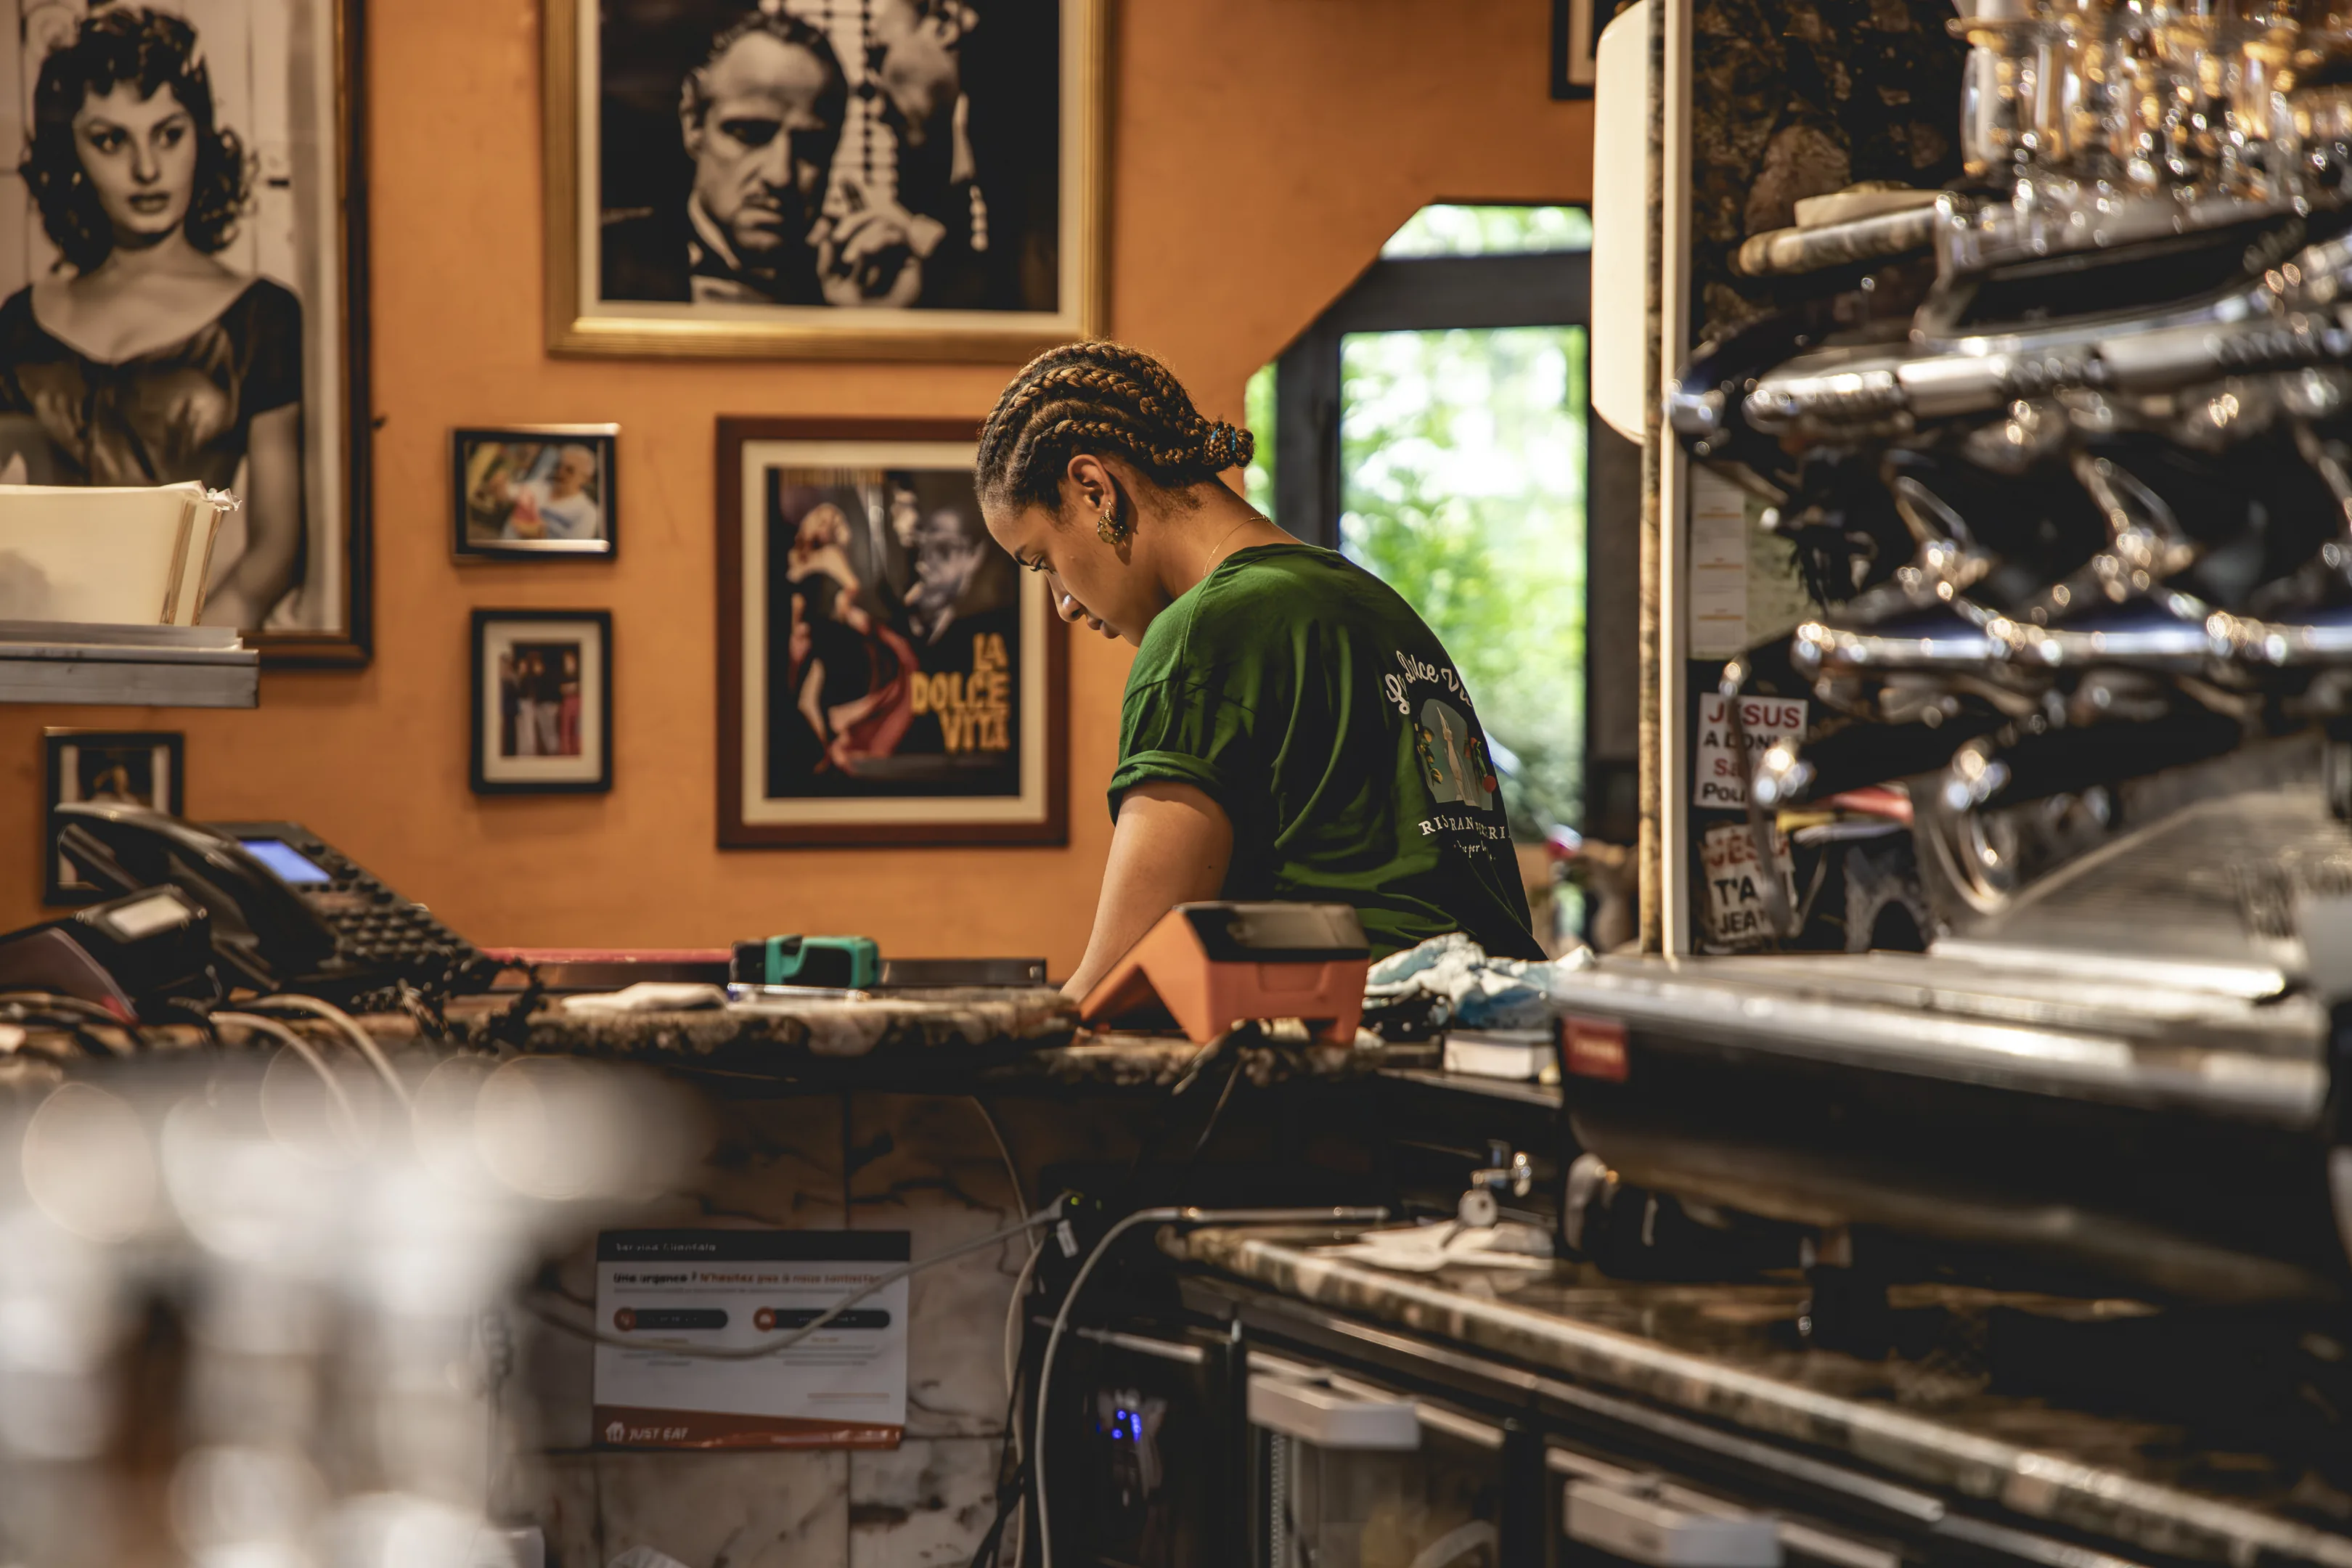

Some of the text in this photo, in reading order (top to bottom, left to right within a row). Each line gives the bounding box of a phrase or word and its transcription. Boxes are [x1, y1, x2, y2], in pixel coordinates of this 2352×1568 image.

[973, 632, 1008, 671] LA
[910, 671, 1010, 716] DOLCE
[1708, 701, 1801, 730] JSUS
[939, 707, 1010, 754] VITA
[1703, 730, 1719, 748] A
[1720, 910, 1765, 934] JEA
[629, 1426, 689, 1442] JUST EAT
